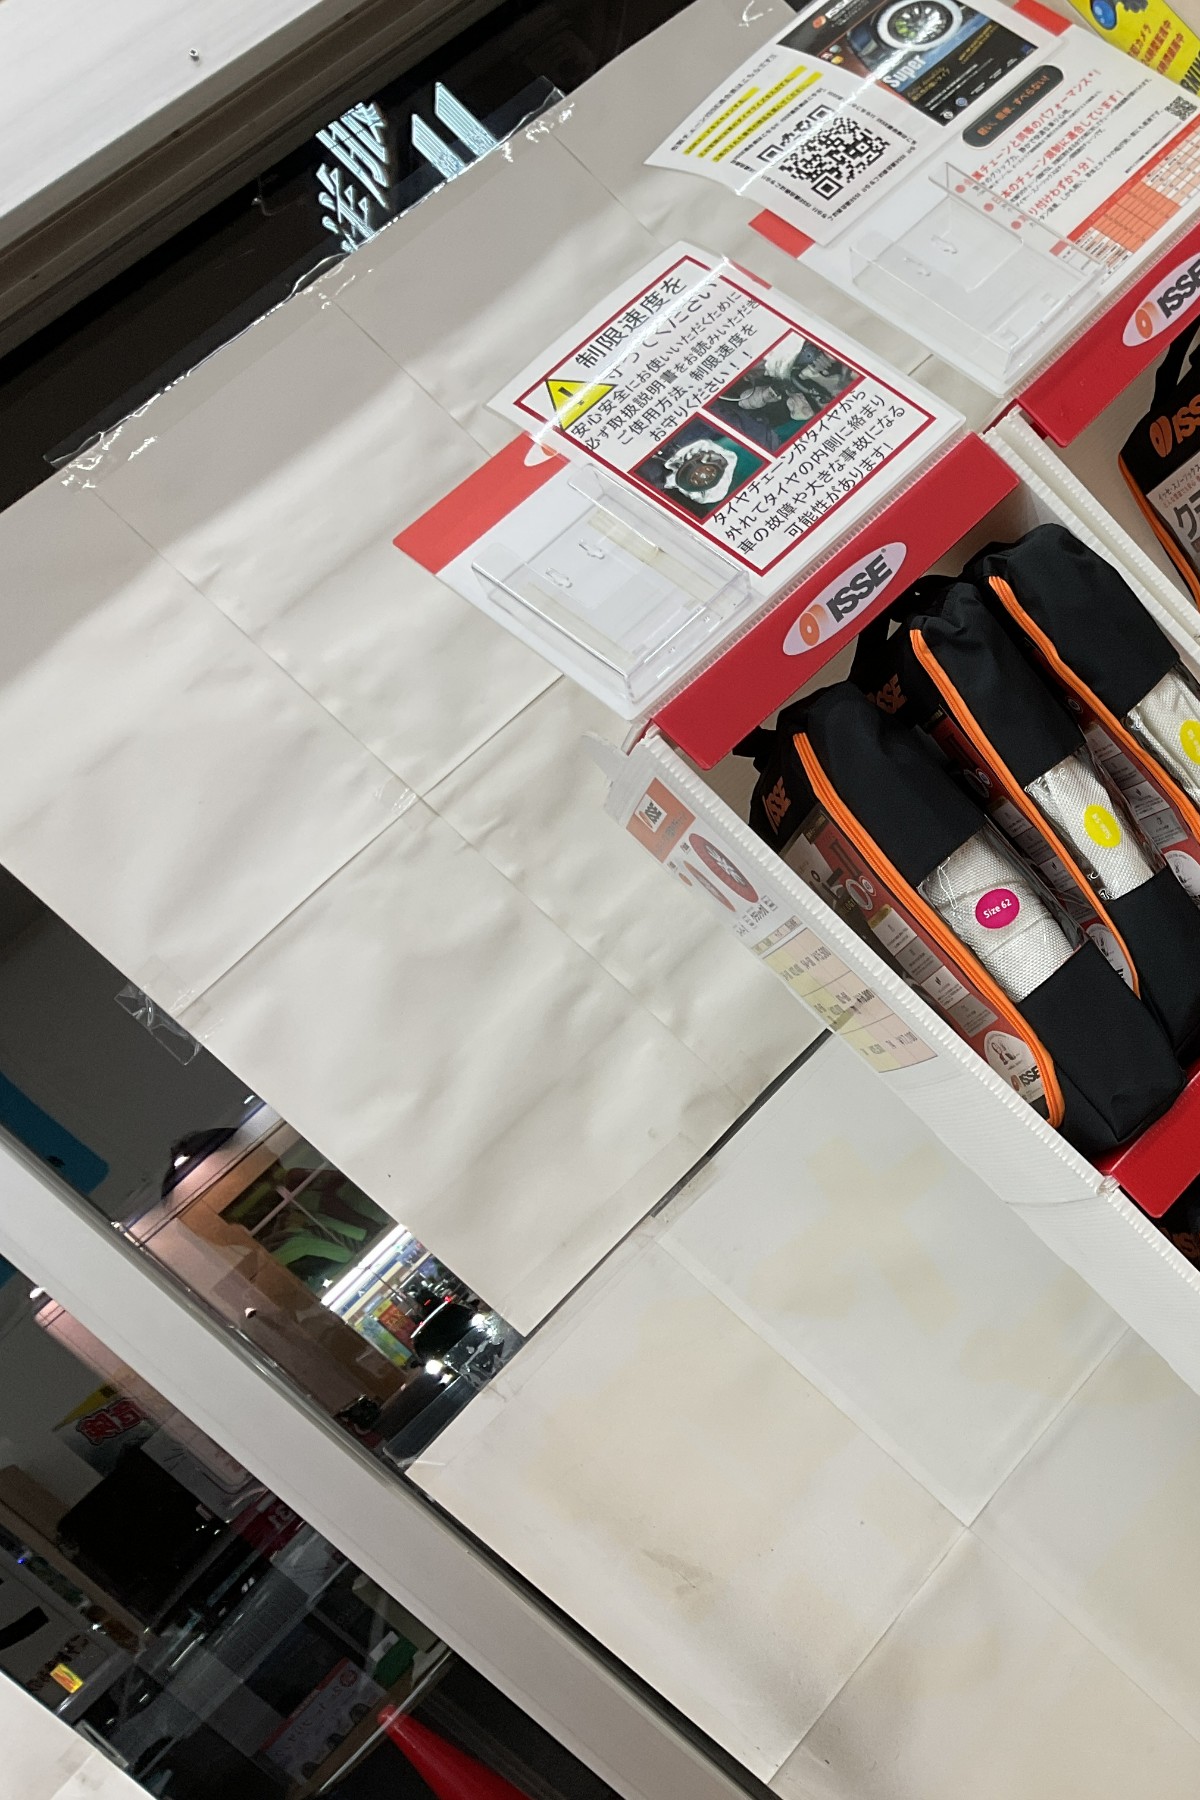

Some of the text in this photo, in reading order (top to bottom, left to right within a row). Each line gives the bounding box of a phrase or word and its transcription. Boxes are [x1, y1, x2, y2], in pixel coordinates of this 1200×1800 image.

[881, 52, 927, 90] Super
[570, 289, 743, 438] 安心安全にお使いいただくために
[574, 274, 687, 372] 制限速度を
[582, 297, 761, 451] 必ず取扱説明書をお読みいただき
[616, 320, 758, 446] ご使用方法、制限速度を
[710, 387, 868, 526] タイヤチェーンがタイヤから
[722, 394, 887, 542] 外れてタイヤの内側に絡まり
[735, 403, 907, 555] 車の故障や大きな事故になる
[827, 552, 893, 624] ISSE
[982, 897, 1012, 918] Size 62
[1018, 1065, 1042, 1087] ISSE
